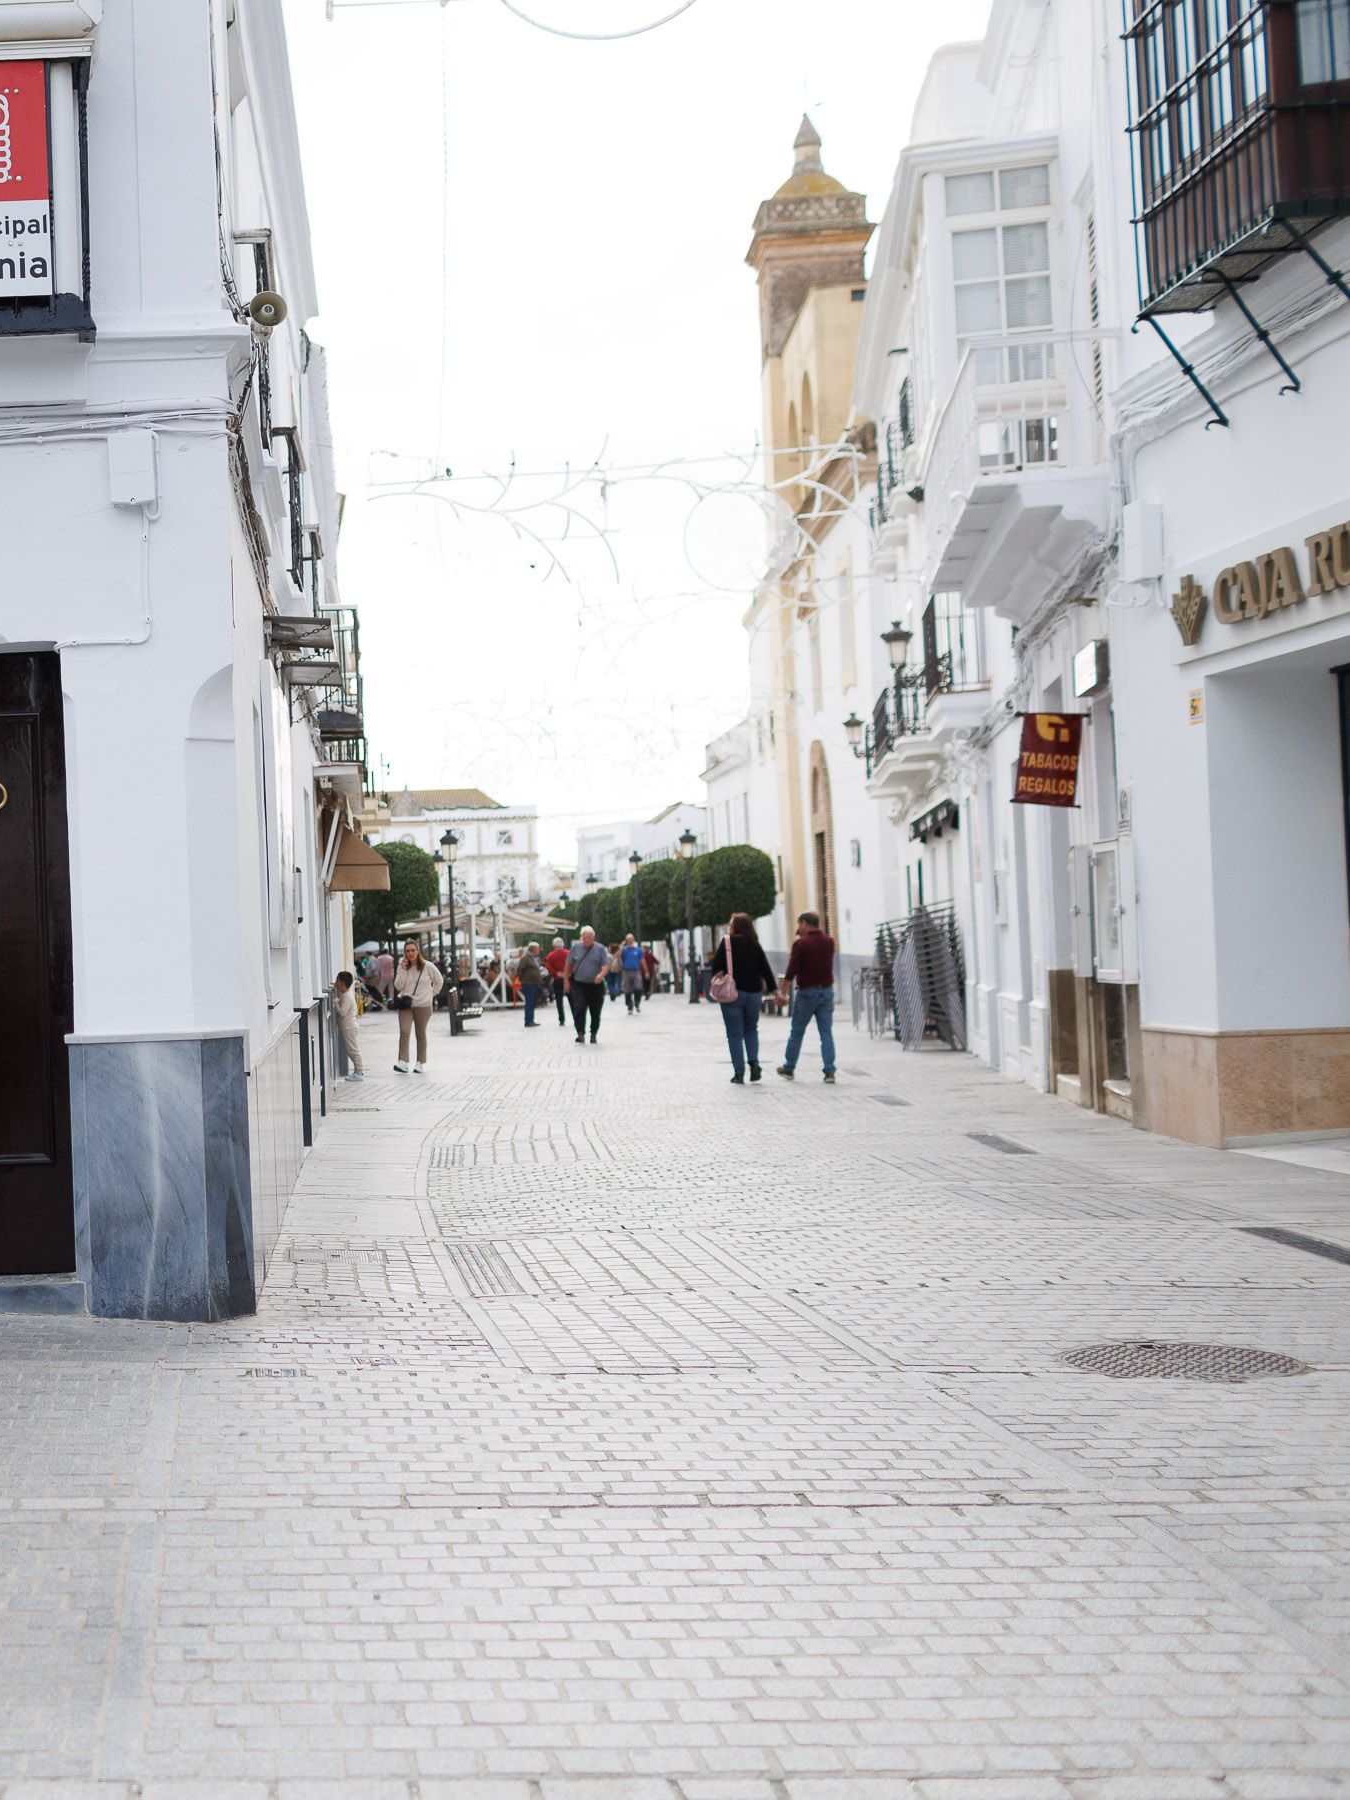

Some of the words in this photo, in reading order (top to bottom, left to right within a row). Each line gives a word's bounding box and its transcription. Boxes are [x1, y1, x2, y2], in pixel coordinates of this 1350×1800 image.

[1213, 546, 1305, 625] CAJA
[1022, 752, 1077, 771] TABACOS
[1018, 776, 1075, 796] REGALOS
